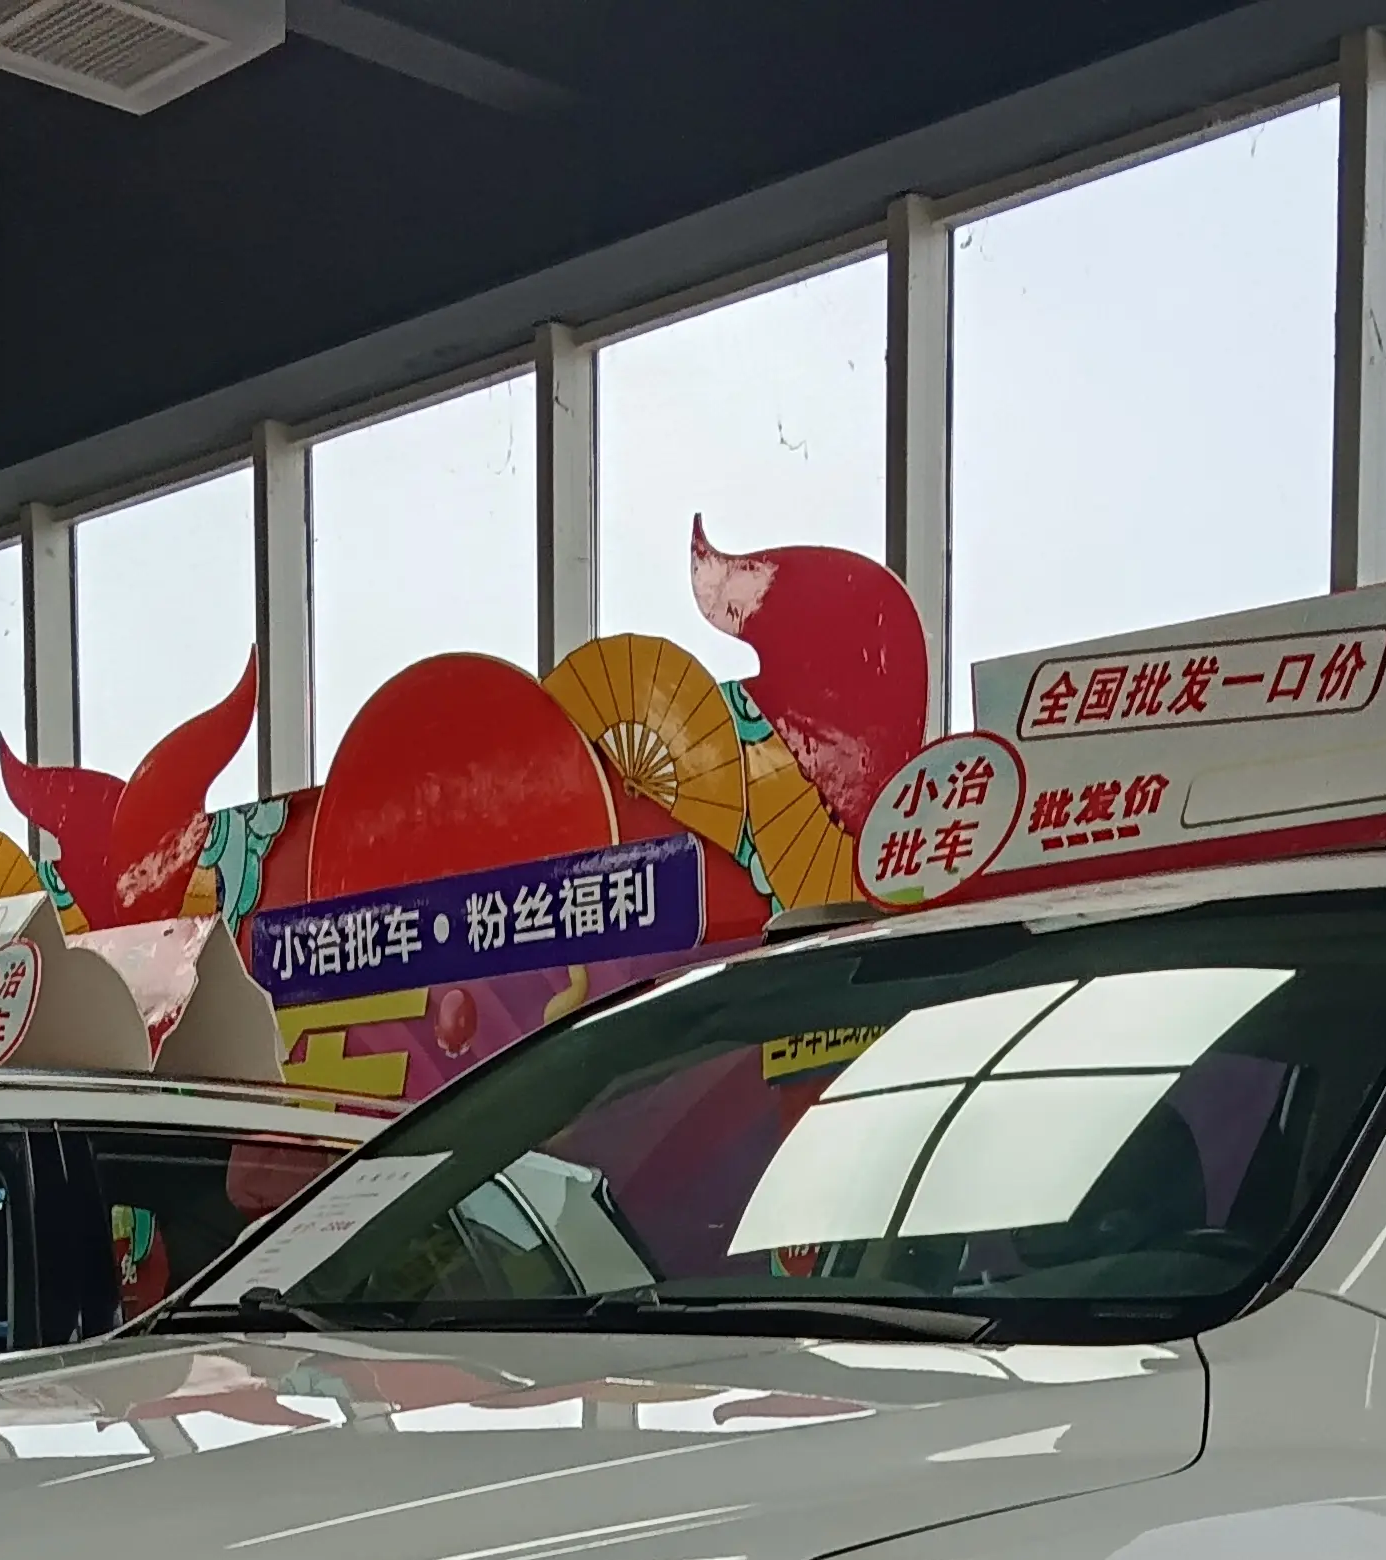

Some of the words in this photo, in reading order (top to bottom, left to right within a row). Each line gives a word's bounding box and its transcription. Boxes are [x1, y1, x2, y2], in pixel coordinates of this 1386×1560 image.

[1030, 640, 1367, 729] 全国批发一口价
[892, 755, 995, 819] 小治
[1027, 773, 1170, 834] 批发价
[875, 819, 980, 882] 批车
